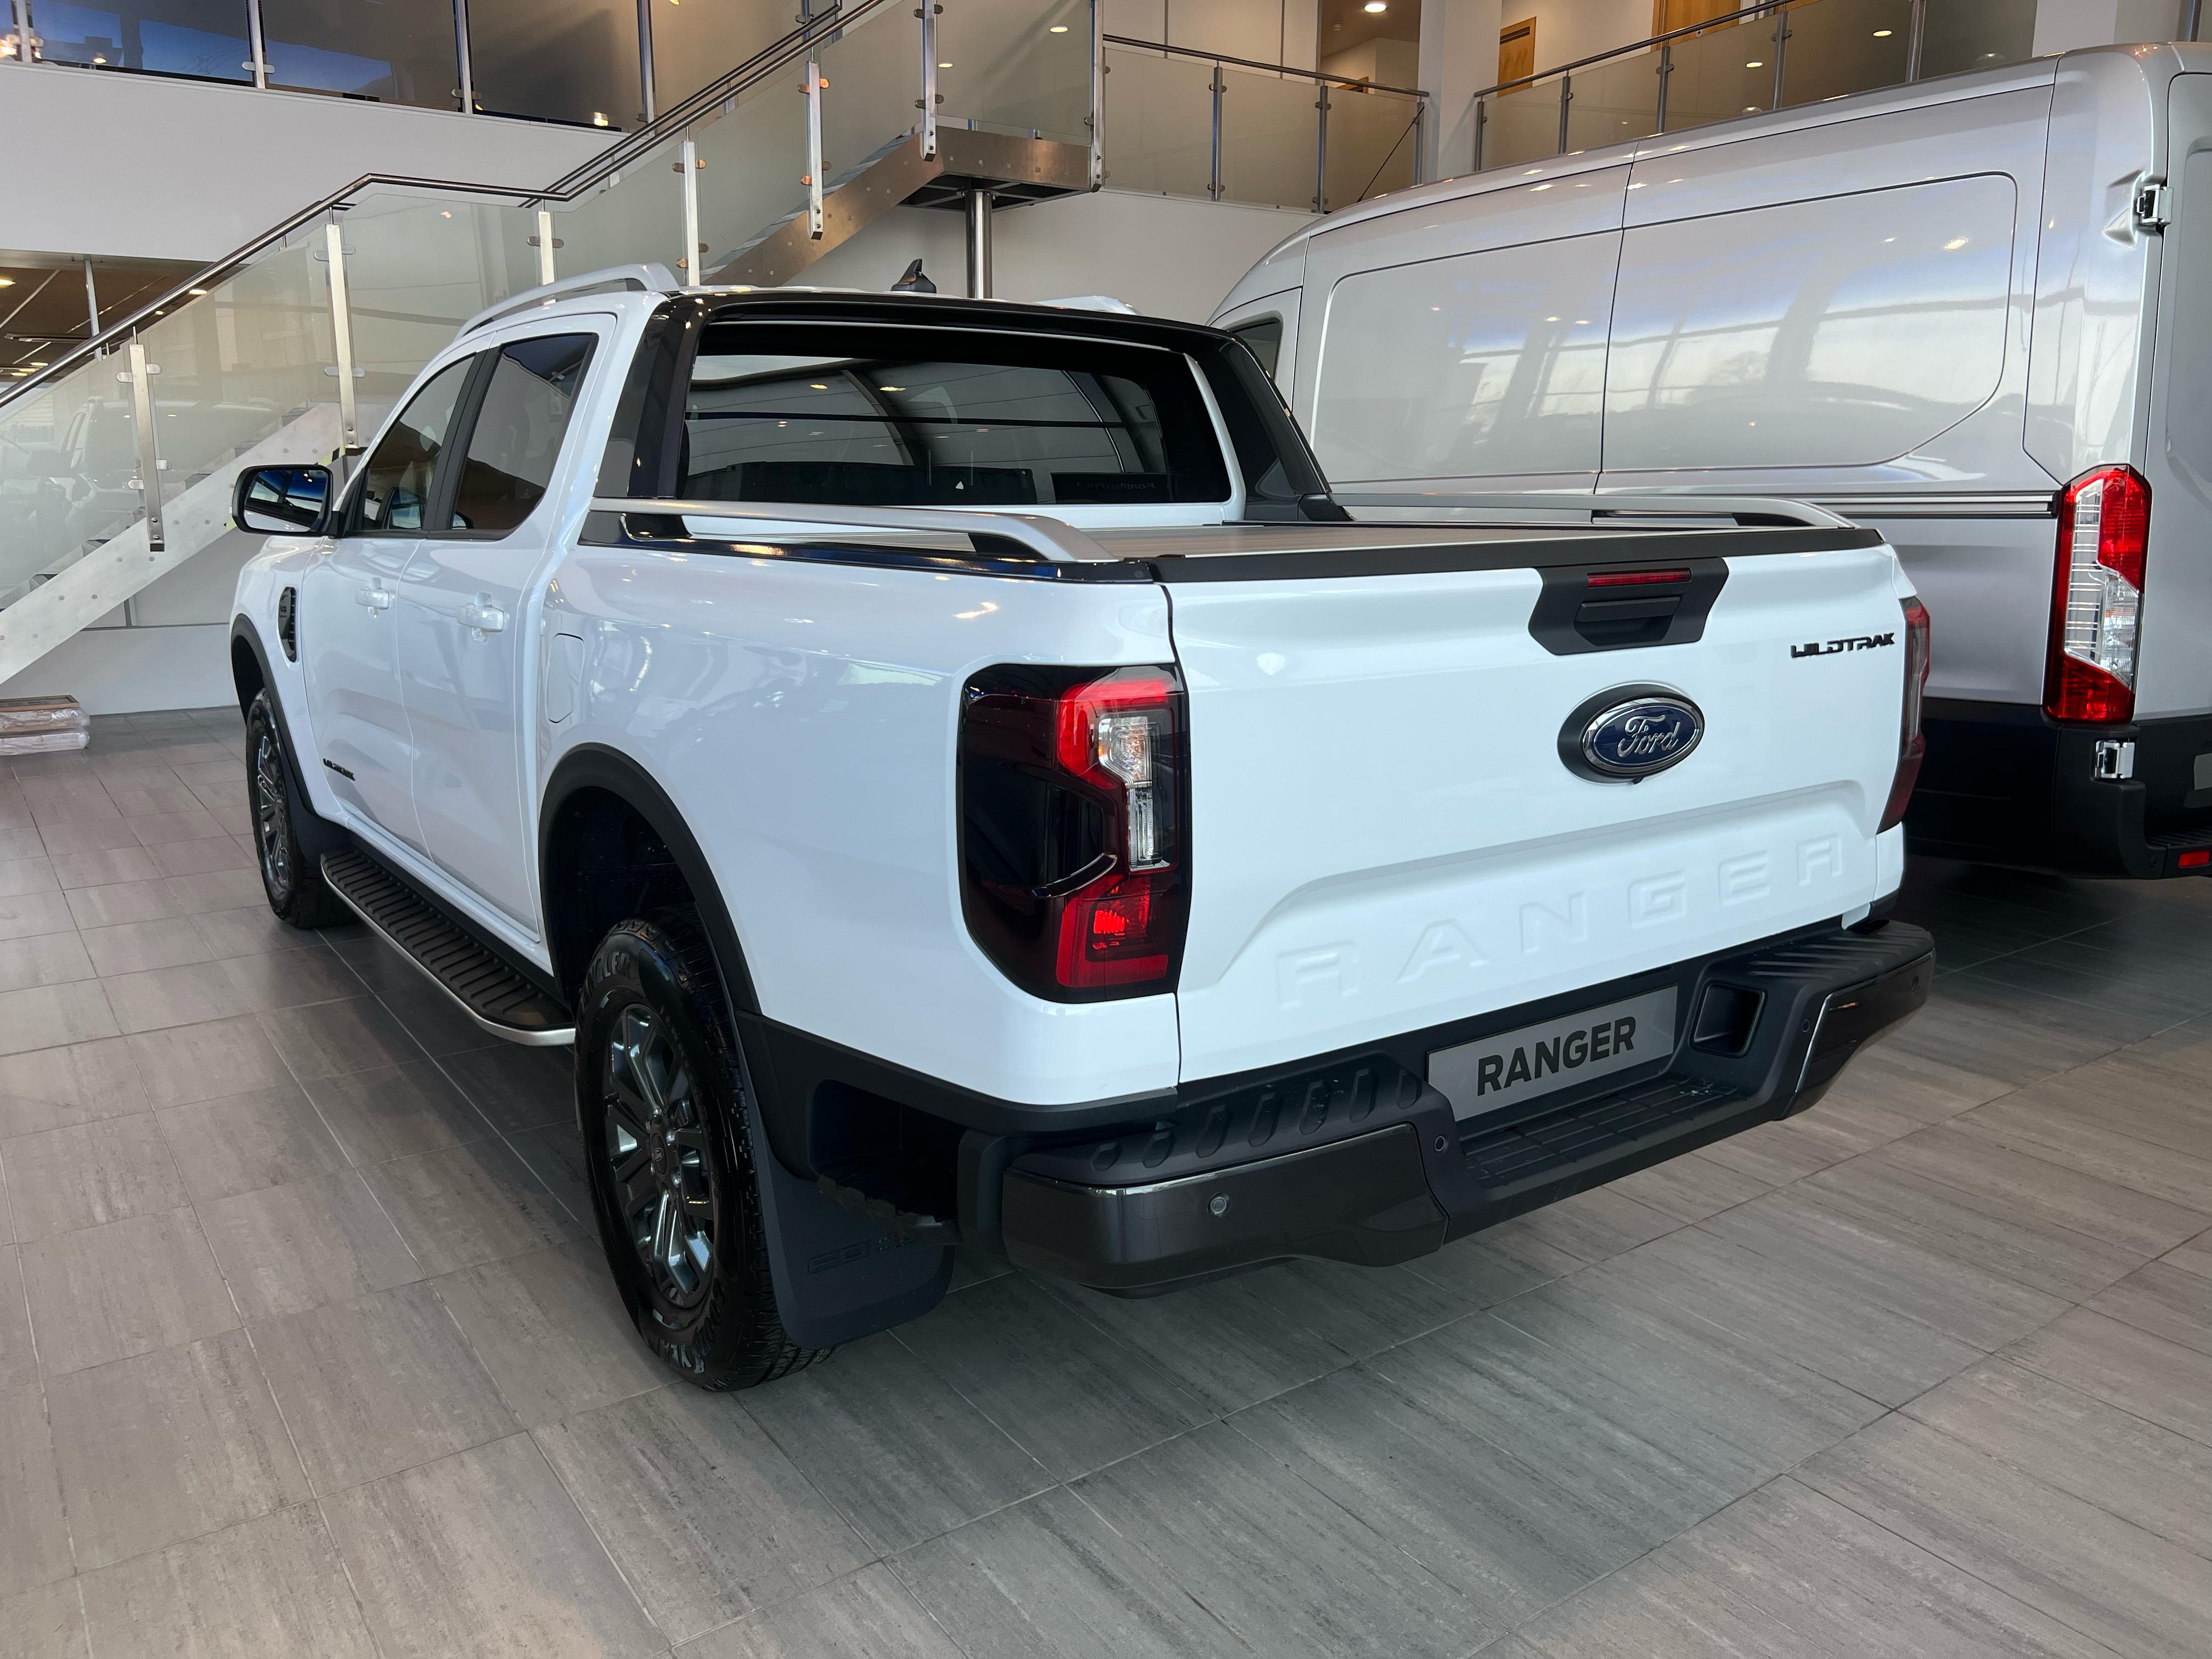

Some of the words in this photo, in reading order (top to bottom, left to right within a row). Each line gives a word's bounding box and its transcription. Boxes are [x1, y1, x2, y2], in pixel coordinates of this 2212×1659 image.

[1791, 633, 1894, 658] WILDTRAK
[1618, 714, 1680, 758] Ford
[1276, 833, 1843, 1011] RANGER
[1477, 1017, 1637, 1096] RANGER
